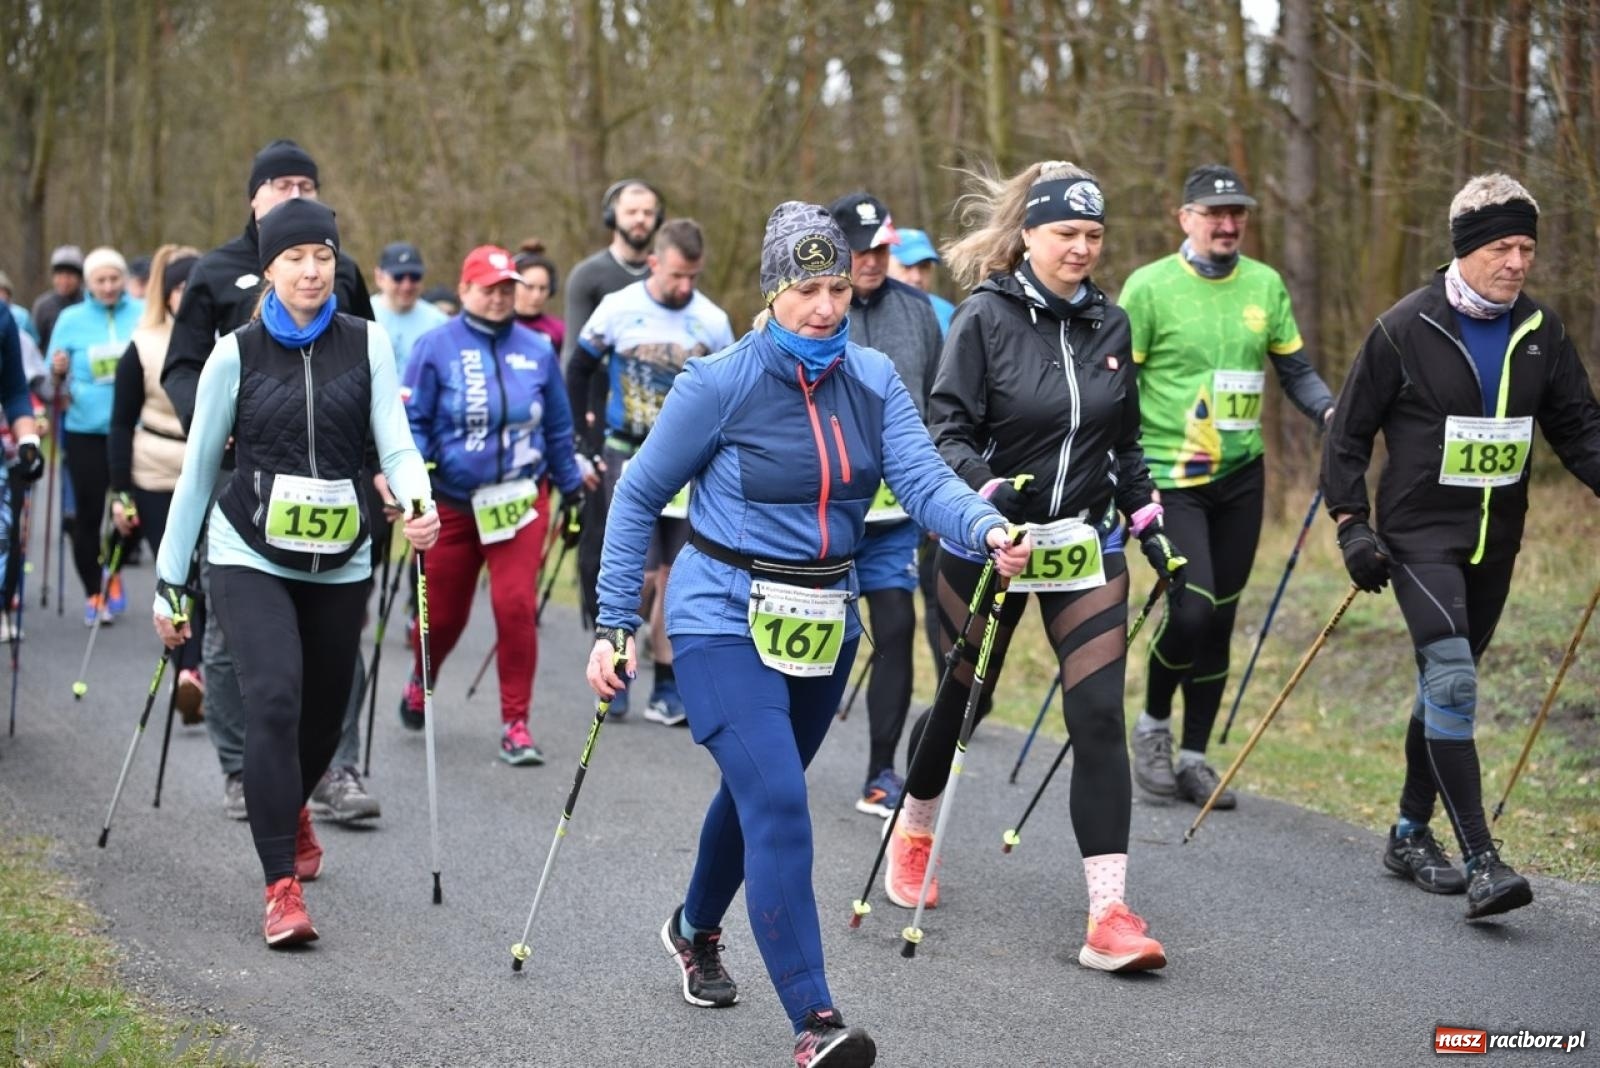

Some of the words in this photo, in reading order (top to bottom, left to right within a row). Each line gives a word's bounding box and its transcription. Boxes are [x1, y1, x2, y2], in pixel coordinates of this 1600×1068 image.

[460, 349, 489, 453] RUNNERS
[1227, 393, 1260, 418] 177
[1459, 443, 1518, 473] 183
[284, 505, 349, 539] 157
[1020, 545, 1087, 579] 159
[764, 618, 835, 660] 167
